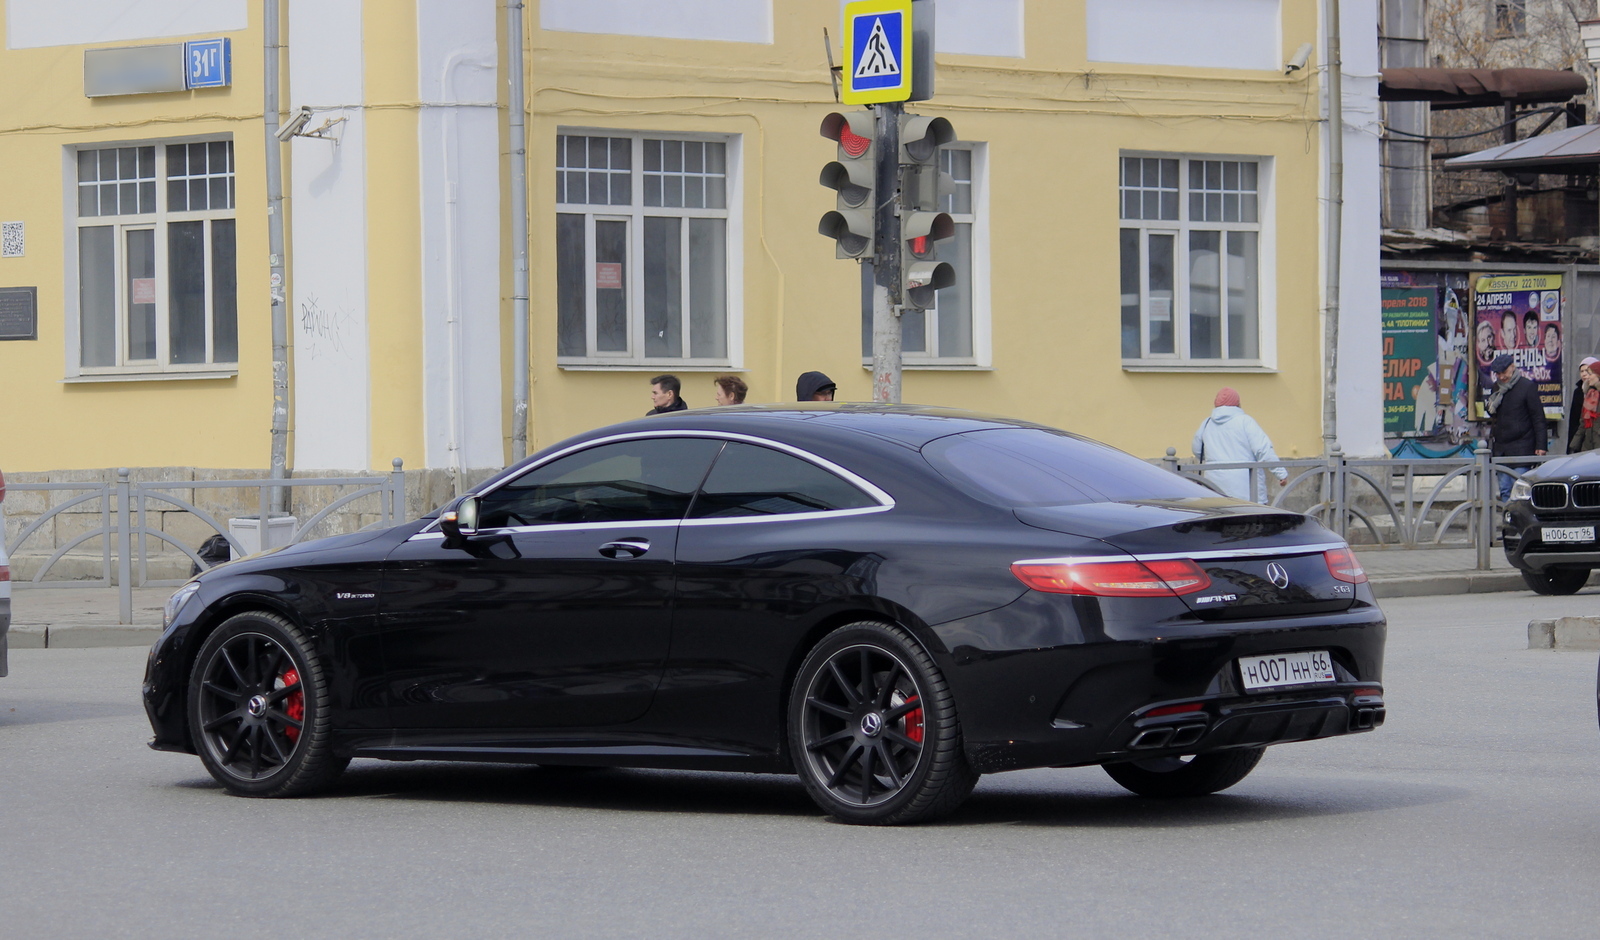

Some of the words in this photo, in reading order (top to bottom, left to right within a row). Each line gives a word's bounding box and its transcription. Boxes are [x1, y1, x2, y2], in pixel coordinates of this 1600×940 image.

[1522, 279, 1532, 289] 222
[1533, 278, 1547, 288] 7000
[1382, 299, 1406, 310] преля
[1407, 296, 1428, 307] 2018
[1476, 294, 1486, 306] 24
[1486, 292, 1513, 304] АПРЕЛЯ
[1493, 348, 1547, 370] ЛЕНДЫ
[1581, 528, 1591, 537] 96
[1209, 594, 1237, 602] AMG
[1312, 653, 1327, 671] 66
